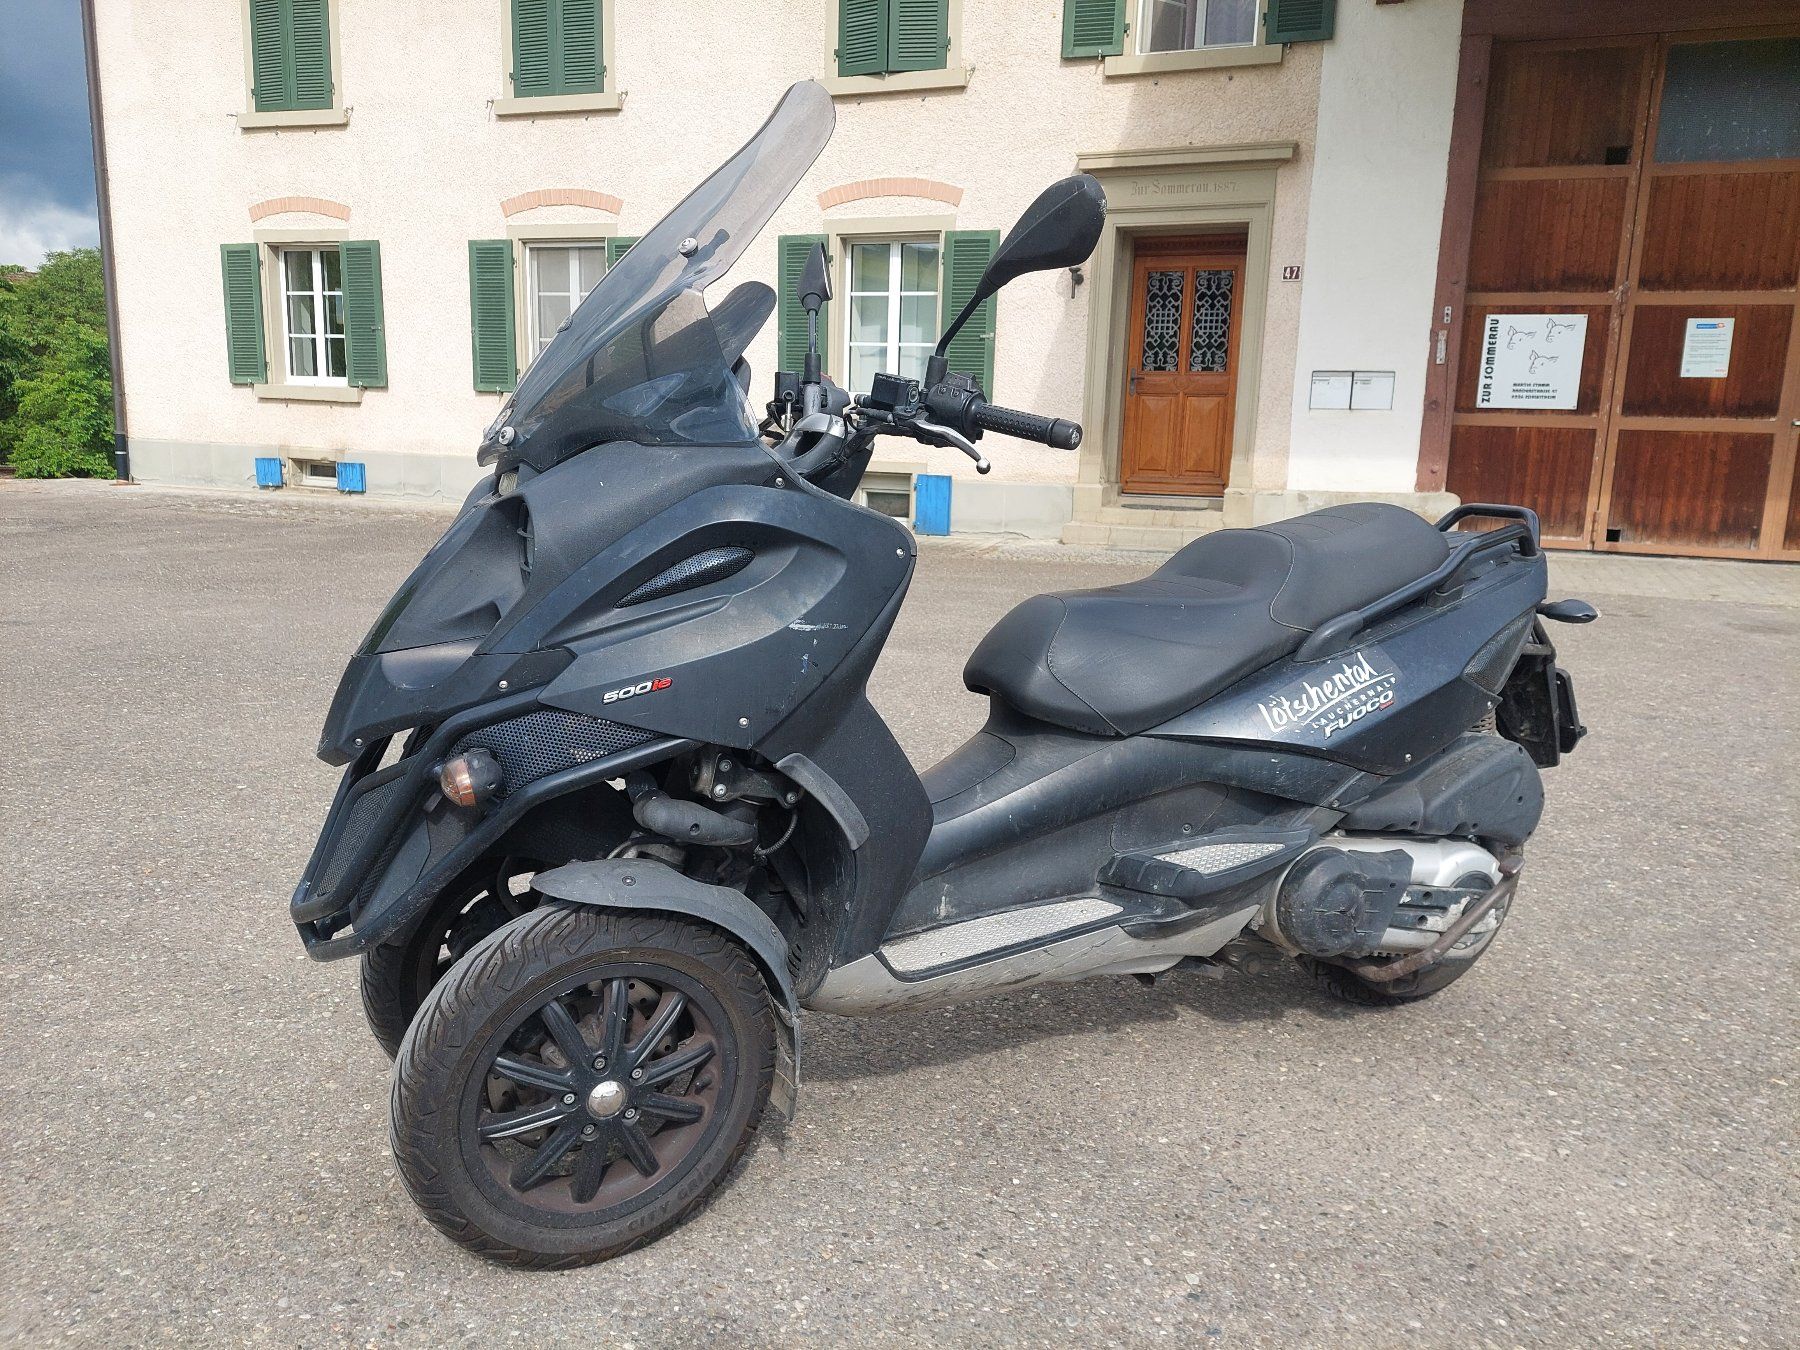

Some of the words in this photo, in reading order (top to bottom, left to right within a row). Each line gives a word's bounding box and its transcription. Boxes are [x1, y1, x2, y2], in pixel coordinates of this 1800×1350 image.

[1285, 267, 1298, 279] 47
[1485, 318, 1500, 380] SOMMERAU
[1481, 383, 1493, 404] ZUR
[1257, 651, 1379, 733] Lötschental
[1323, 690, 1395, 740] FUOCO
